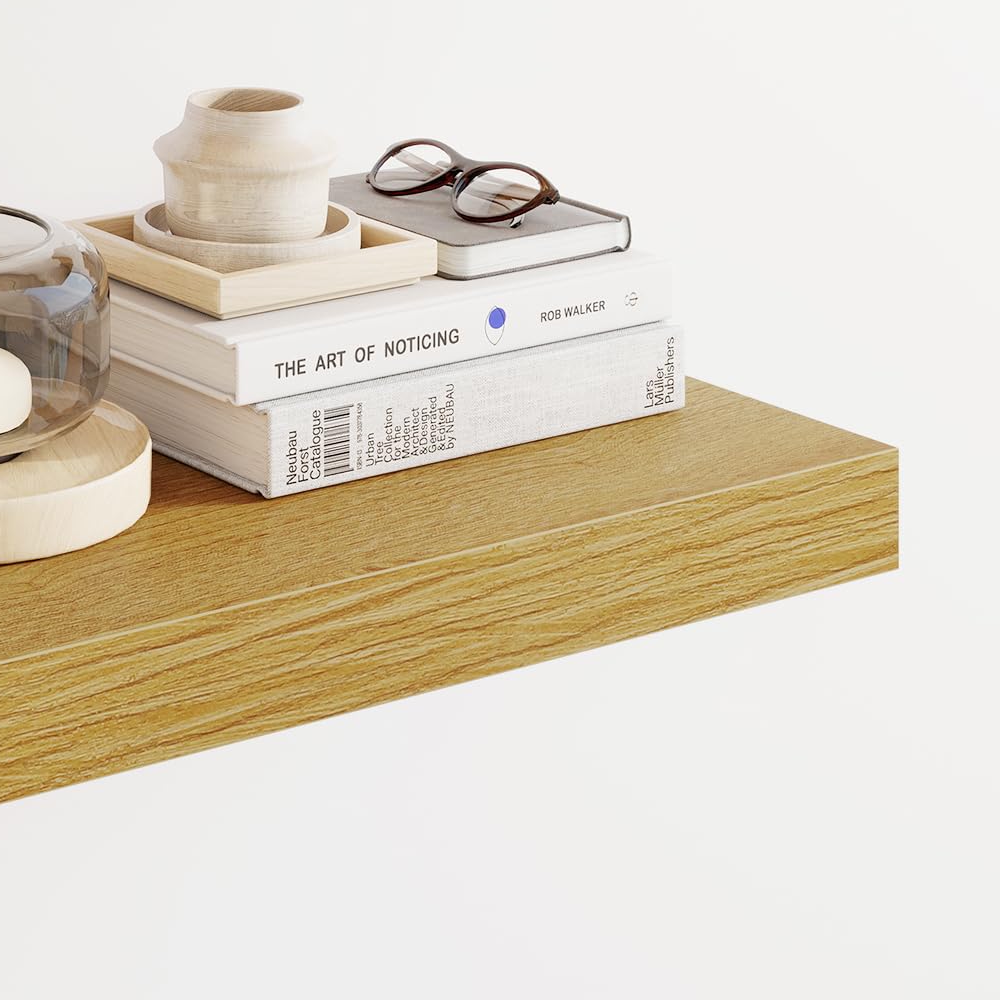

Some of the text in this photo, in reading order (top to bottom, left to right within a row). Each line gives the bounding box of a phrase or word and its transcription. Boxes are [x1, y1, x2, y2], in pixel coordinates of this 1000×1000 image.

[540, 300, 606, 323] ROB WALKER
[275, 328, 460, 380] THE ART OF NOTICING
[664, 336, 675, 404] Publishers
[644, 379, 654, 409] Lars
[654, 366, 664, 406] Müller
[384, 407, 393, 462] Collection
[402, 416, 410, 459] Modern
[411, 407, 419, 456] Architect
[428, 396, 437, 453] Generated
[446, 383, 456, 449] by NEUBAU
[286, 430, 298, 485] Neubau
[298, 447, 309, 483] Forst
[310, 409, 323, 480] Catalogue
[366, 433, 374, 467] Urban
[375, 441, 384, 465] Tree
[392, 425, 401, 461] for the
